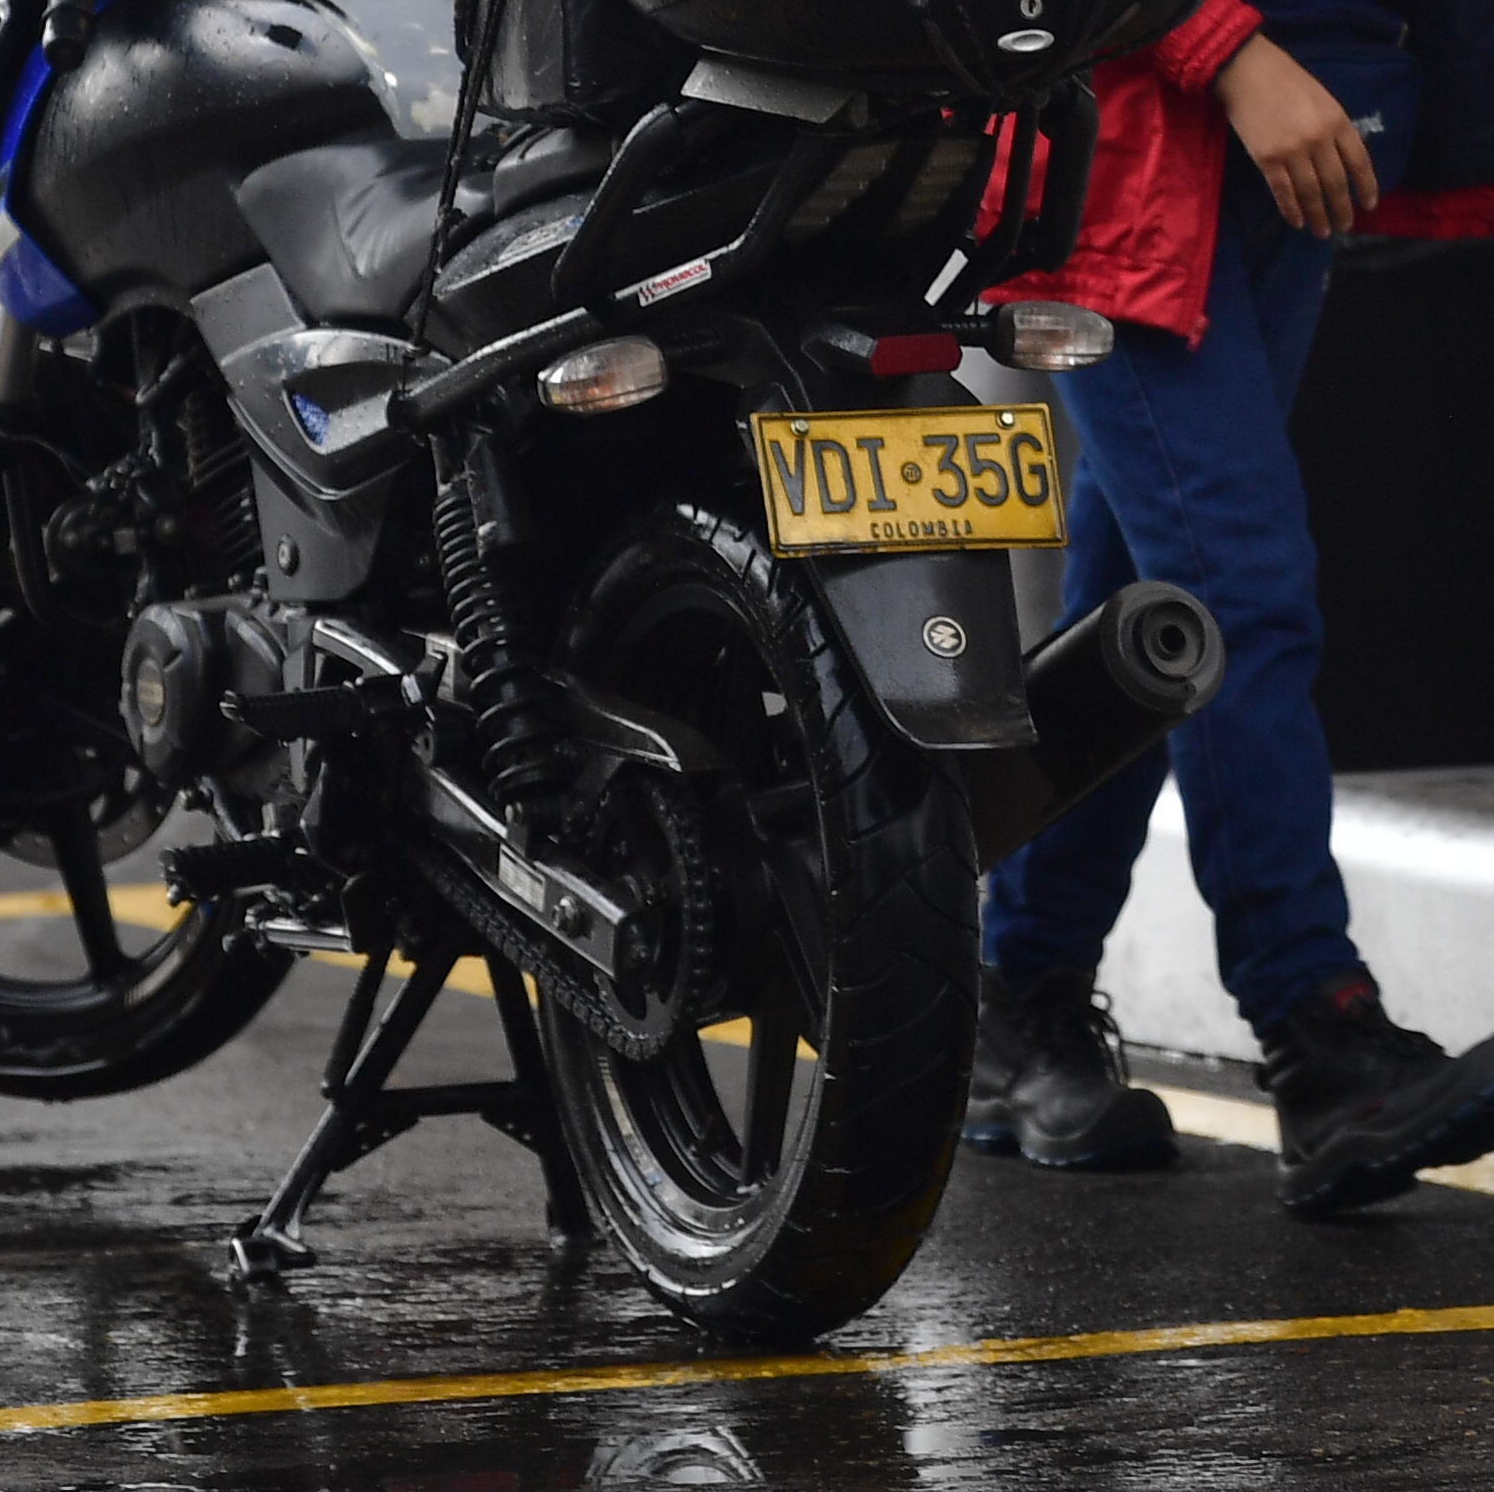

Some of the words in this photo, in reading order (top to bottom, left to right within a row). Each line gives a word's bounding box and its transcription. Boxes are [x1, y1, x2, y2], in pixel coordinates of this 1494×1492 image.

[769, 437, 898, 516] VDI
[922, 432, 1050, 508] 35G
[870, 519, 974, 539] COLOMBIA
